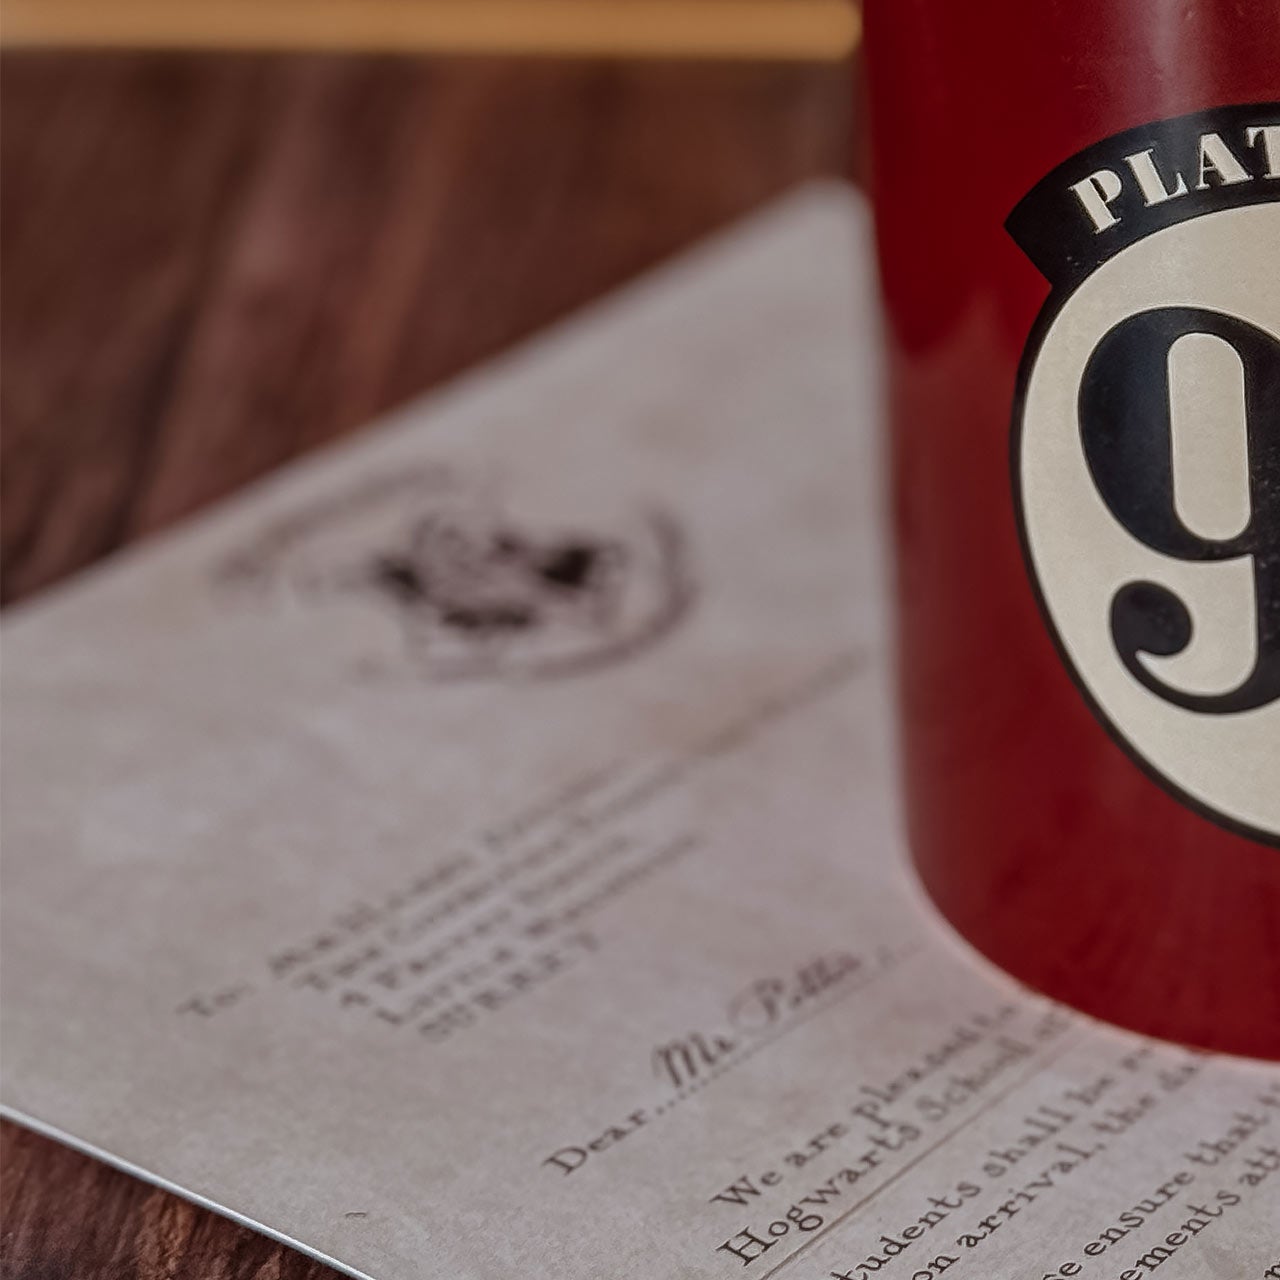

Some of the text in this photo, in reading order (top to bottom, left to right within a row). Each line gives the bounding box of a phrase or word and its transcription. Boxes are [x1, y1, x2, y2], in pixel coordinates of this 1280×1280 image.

[709, 1169, 784, 1208] We
[784, 1121, 848, 1168] are
[714, 1120, 922, 1267] Hogwarts
[1083, 1170, 1196, 1257] ensure
